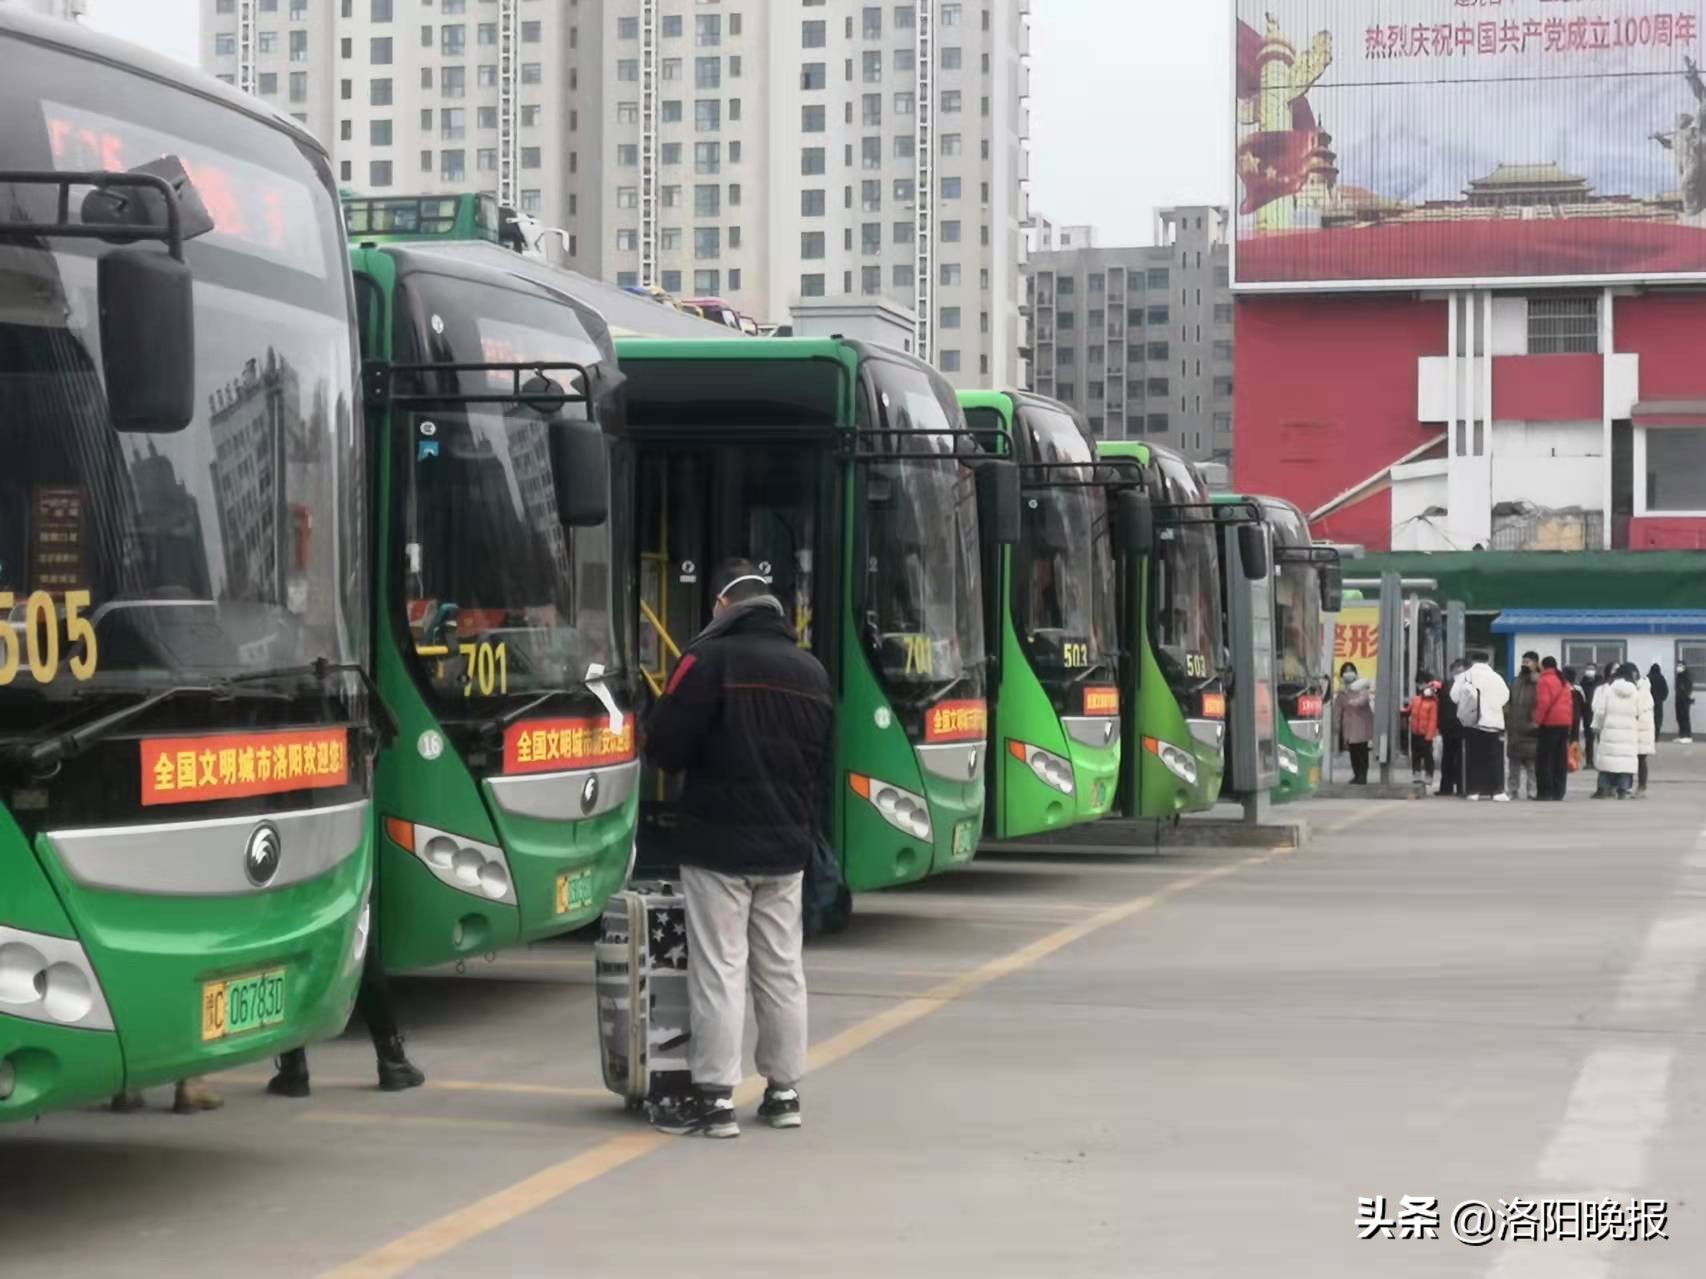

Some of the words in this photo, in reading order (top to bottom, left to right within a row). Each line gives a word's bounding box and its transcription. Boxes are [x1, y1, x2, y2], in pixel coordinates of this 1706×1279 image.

[1365, 12, 1697, 60] 热烈庆祝中国共产党成立100周年
[459, 641, 507, 697] 701
[1063, 643, 1088, 668] 503
